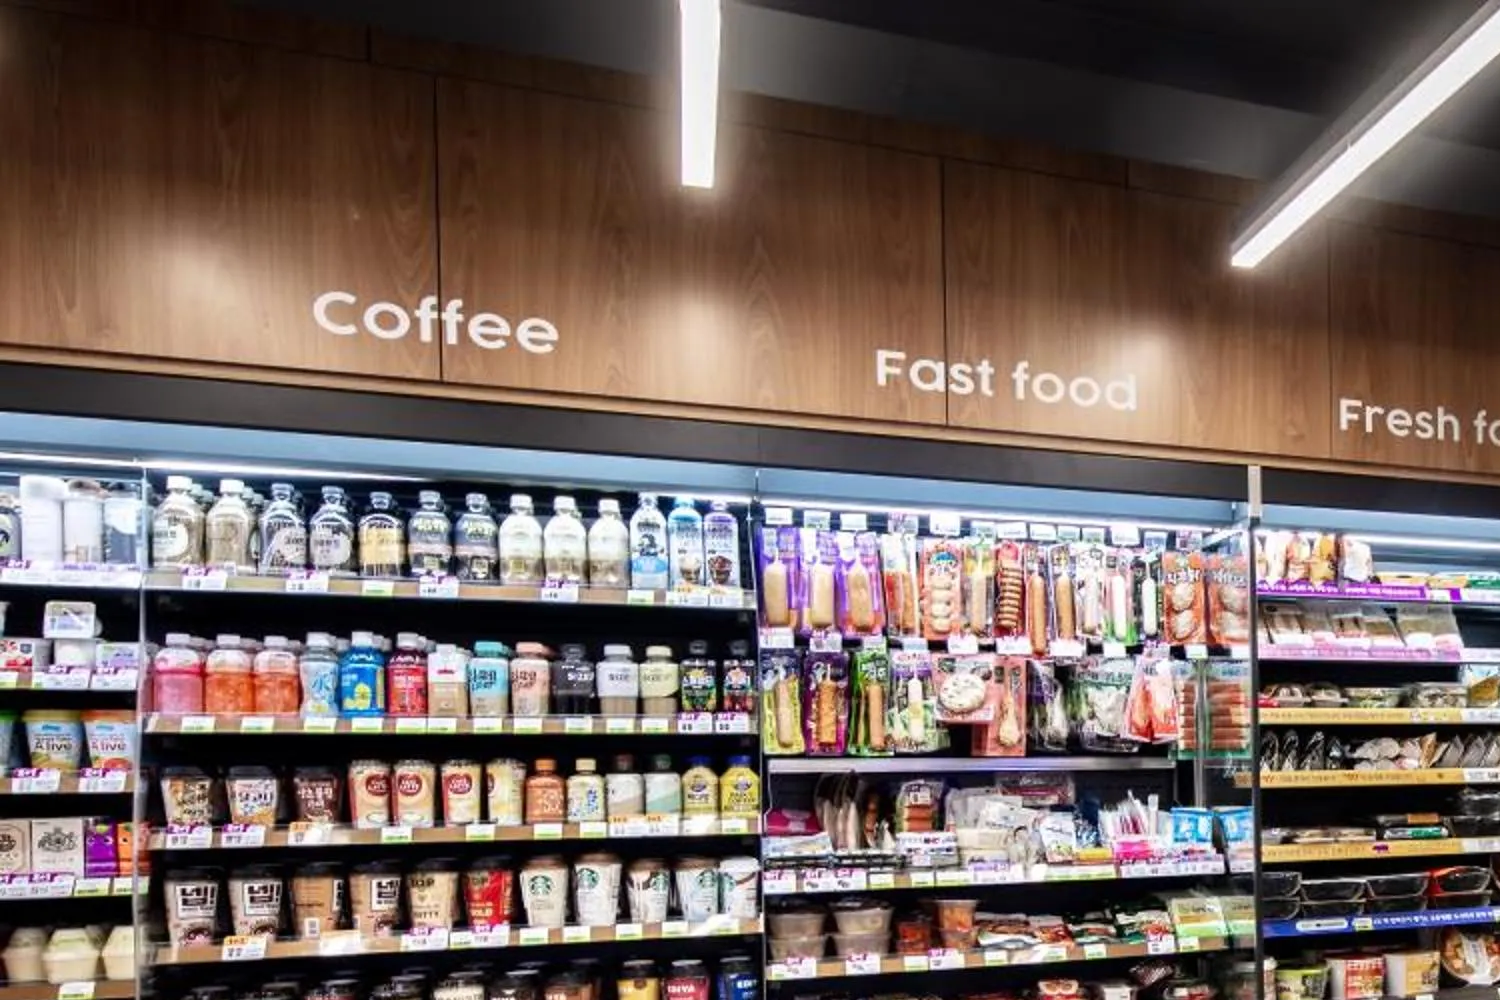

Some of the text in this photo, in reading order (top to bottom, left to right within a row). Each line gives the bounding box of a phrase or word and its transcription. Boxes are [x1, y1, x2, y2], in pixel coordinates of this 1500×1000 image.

[313, 290, 560, 354] Coffee
[875, 349, 1137, 412] Fast food
[1339, 398, 1461, 443] Fresh
